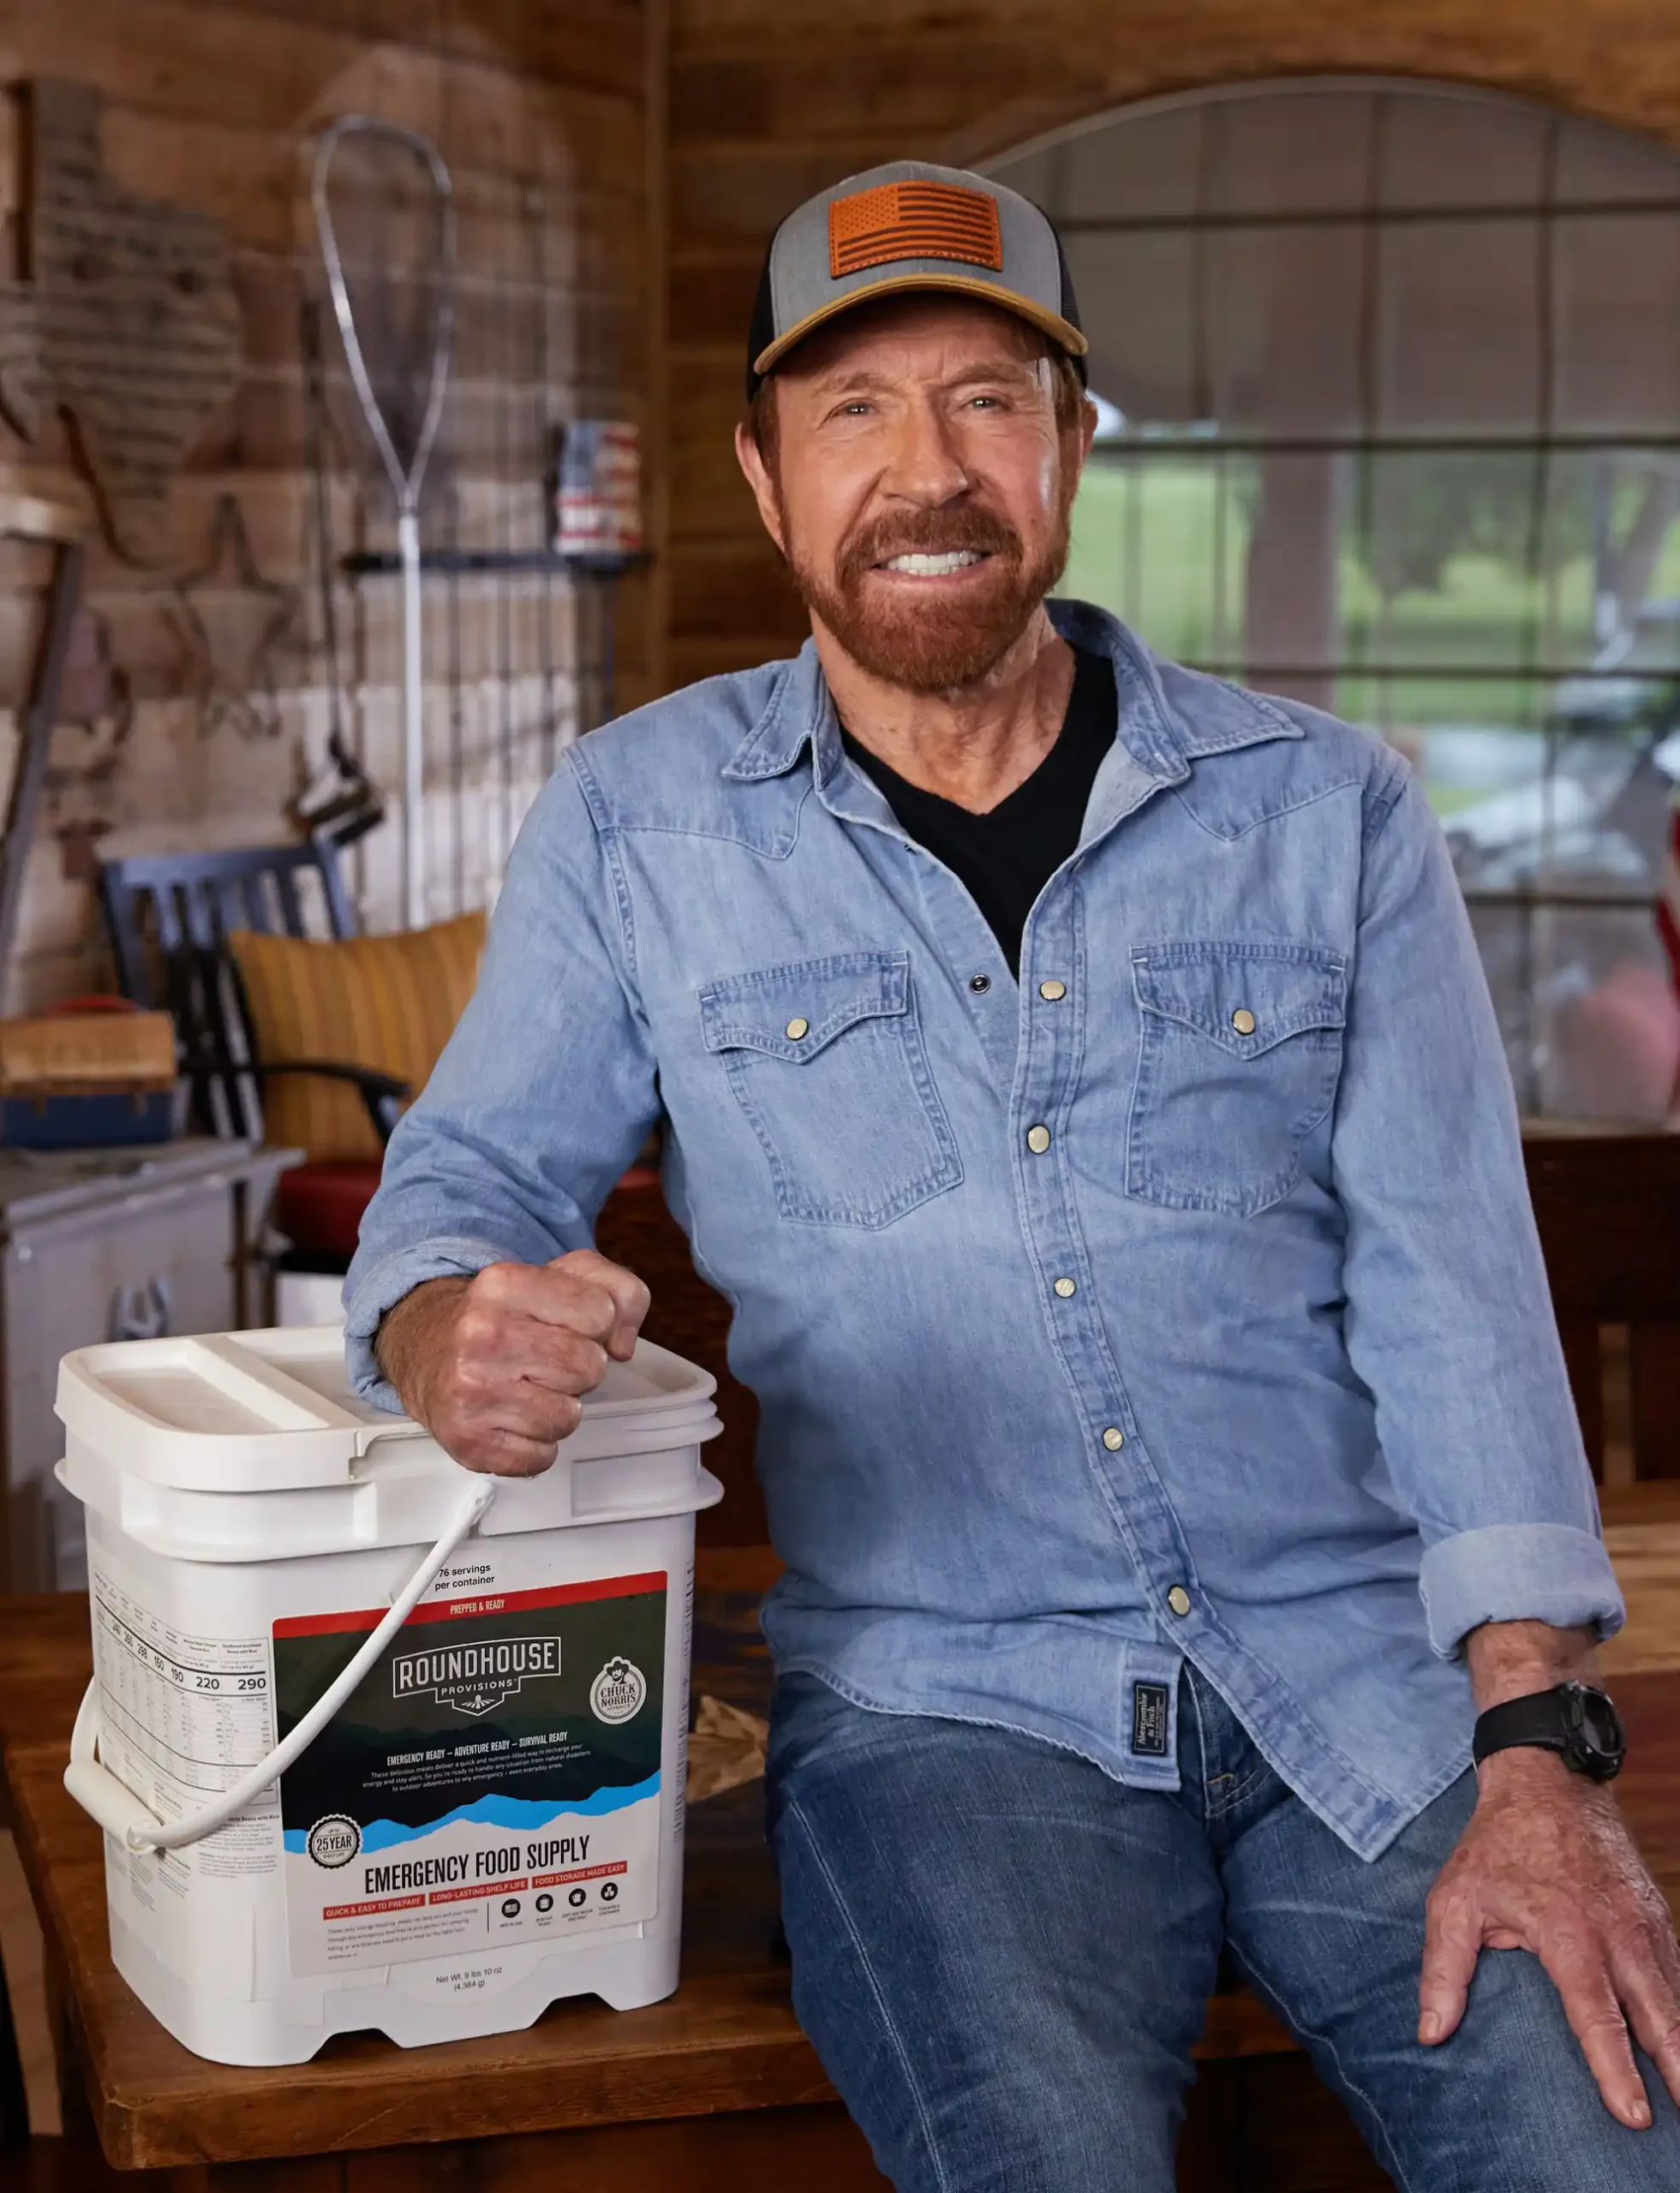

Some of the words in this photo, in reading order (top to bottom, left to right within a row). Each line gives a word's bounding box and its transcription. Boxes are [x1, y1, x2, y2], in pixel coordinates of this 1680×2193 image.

[439, 1569, 450, 1577] 76
[451, 1564, 491, 1575] servings
[435, 1582, 450, 1592] per
[452, 1576, 495, 1588] container
[450, 1602, 477, 1615] PREPPED
[479, 1602, 484, 1611] &
[486, 1598, 505, 1610] READY
[399, 1641, 555, 1689] ROUNDHOUSE
[171, 1668, 183, 1682] 190
[196, 1676, 220, 1690] 220
[237, 1677, 266, 1690] 290
[601, 1683, 635, 1698] CHUCK
[601, 1694, 636, 1707] NORRIS
[1138, 1693, 1148, 1745] Abercrombie
[387, 1752, 424, 1766] EMERGENCY
[426, 1749, 445, 1760] READY
[454, 1742, 489, 1757] ADVENTURE
[491, 1740, 511, 1752] READY
[518, 1735, 547, 1748] SURVIVAL
[549, 1731, 568, 1743] READY
[460, 1759, 475, 1767] quick
[545, 1746, 570, 1754] recharge
[451, 1767, 467, 1776] ready
[545, 1754, 565, 1762] natural
[399, 1783, 421, 1791] outdoor
[422, 1778, 454, 1788] adventures
[472, 1772, 504, 1780] emergency
[523, 1765, 547, 1773] everyday
[317, 1837, 329, 1851] 25
[330, 1835, 352, 1849] YEAR
[365, 1854, 469, 1894] EMERGENCY
[475, 1846, 521, 1878] FOOD
[526, 1835, 591, 1870] SUPPLY
[535, 1875, 554, 1885] FOOD
[555, 1870, 587, 1883] STORAGE
[588, 1867, 607, 1877] MADE
[607, 1864, 625, 1874] EASY
[433, 1885, 486, 1902] LONG-LASTING
[486, 1882, 510, 1894] SHELF
[511, 1880, 526, 1889] LIFE
[326, 1908, 350, 1917] QUICK
[350, 1906, 356, 1915] &
[358, 1903, 377, 1914] EASY
[378, 1902, 388, 1910] TO
[389, 1897, 421, 1909] PREPARE
[436, 1975, 449, 1984] Net
